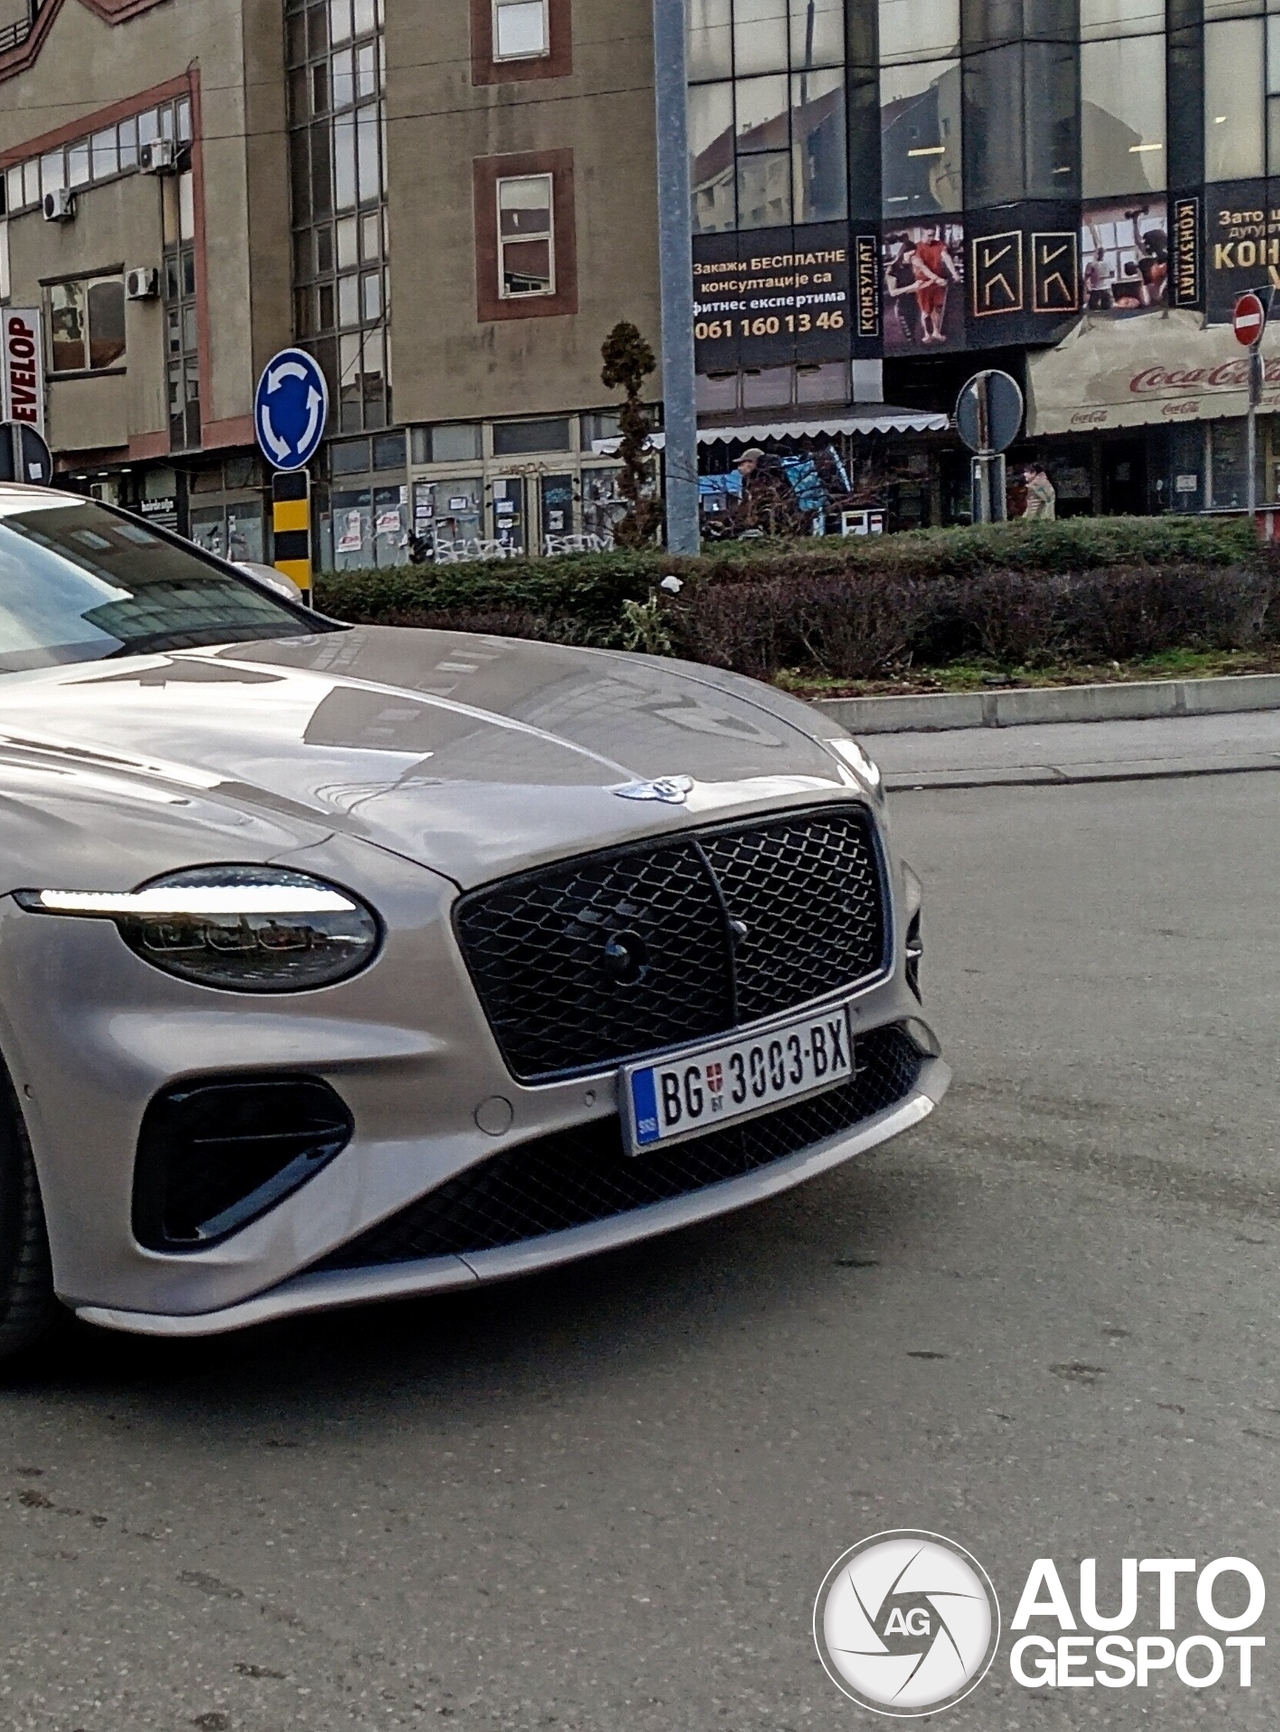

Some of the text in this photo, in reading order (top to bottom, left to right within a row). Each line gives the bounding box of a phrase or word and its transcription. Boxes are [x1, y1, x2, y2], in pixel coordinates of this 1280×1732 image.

[1218, 210, 1264, 225] Зато
[693, 250, 846, 275] Закажи БЕСПЛАТНЕ
[701, 271, 832, 293] консултације са
[692, 291, 846, 316] фитнес експертима
[695, 311, 844, 339] 061 160 13 46
[660, 1065, 704, 1127] BG
